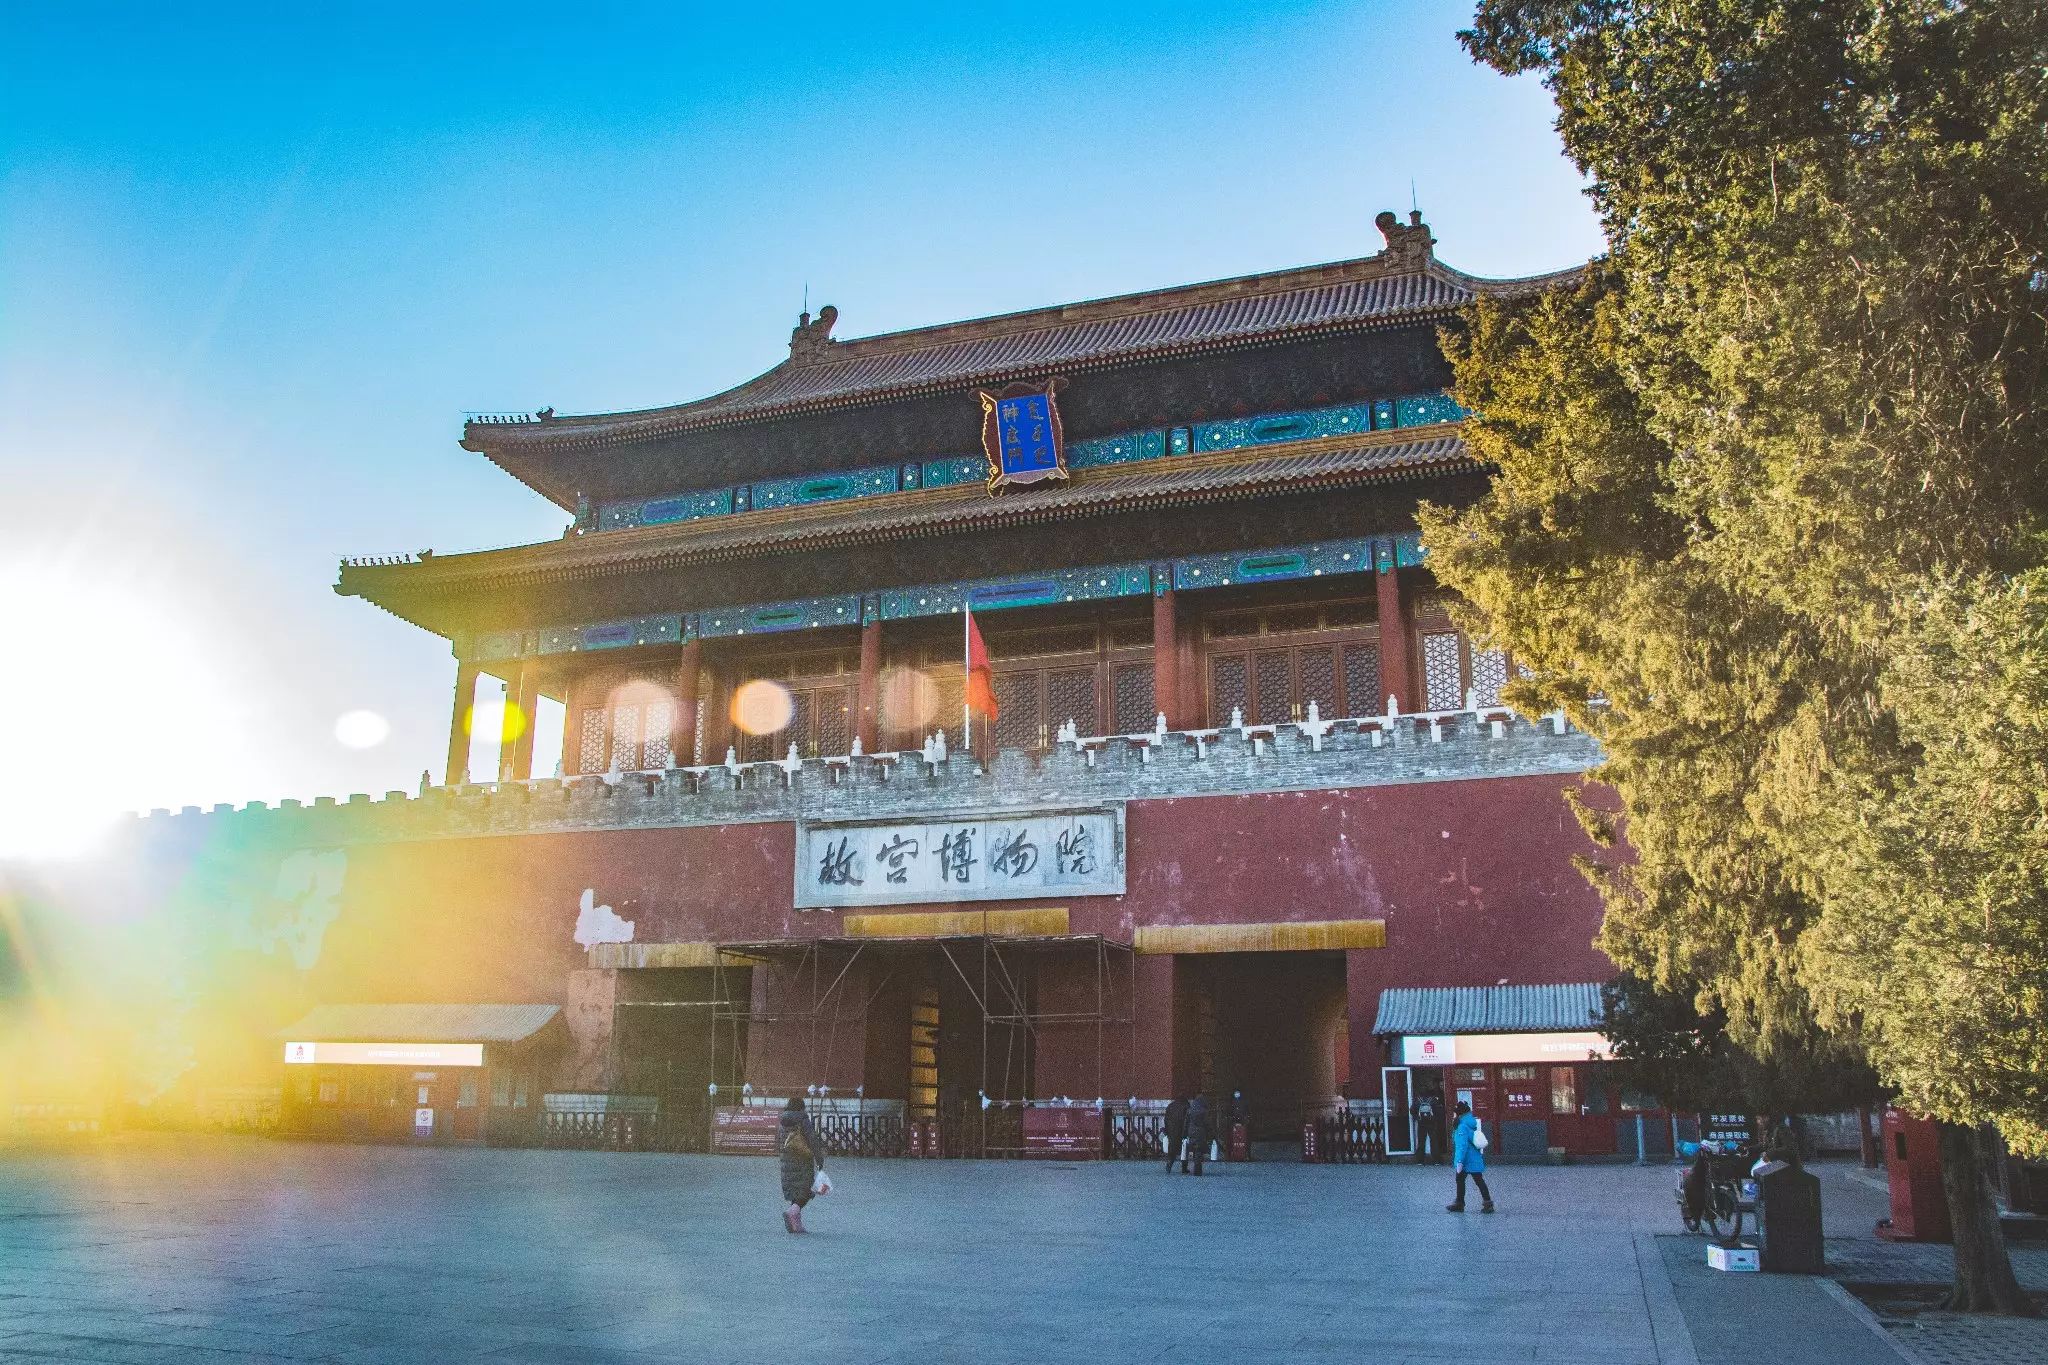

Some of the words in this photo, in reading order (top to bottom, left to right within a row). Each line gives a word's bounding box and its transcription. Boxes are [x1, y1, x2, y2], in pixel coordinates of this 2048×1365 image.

[818, 824, 1097, 887] 故宫博物院
